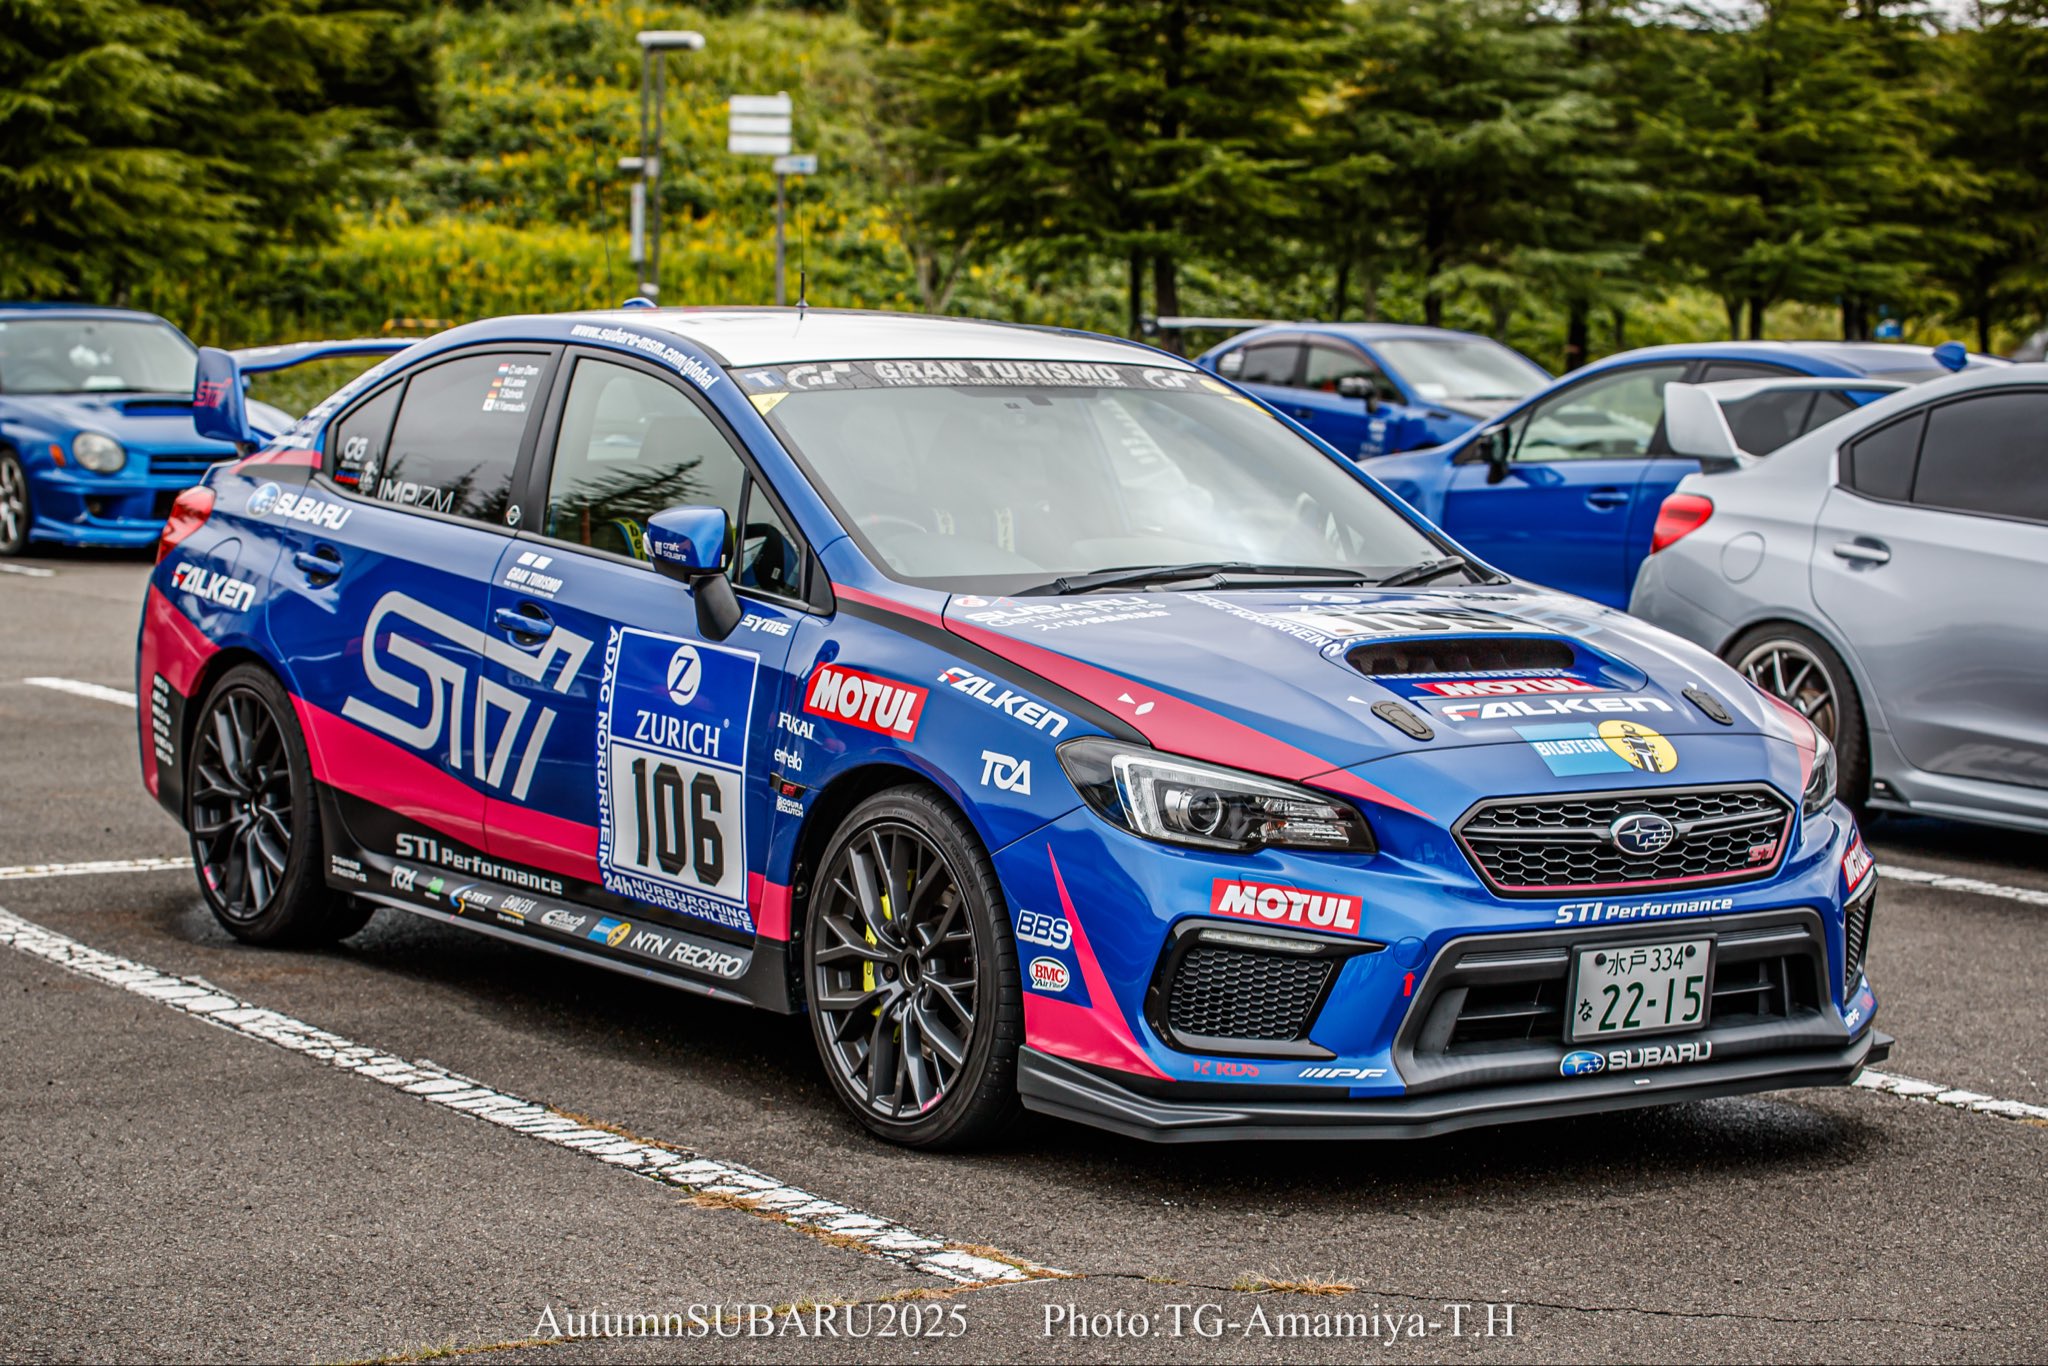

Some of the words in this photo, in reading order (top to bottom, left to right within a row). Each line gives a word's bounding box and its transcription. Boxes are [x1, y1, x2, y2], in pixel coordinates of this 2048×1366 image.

[874, 362, 968, 378] GRAN
[971, 361, 1120, 380] TURISMO
[344, 437, 368, 460] CG
[274, 491, 352, 531] SUBARU
[171, 562, 257, 612] FALKEN
[507, 567, 530, 583] GRAN
[526, 572, 563, 593] TURISMO
[966, 597, 1149, 621] SUBARU
[987, 609, 1096, 626] Genuine
[1097, 603, 1166, 612] Parts
[600, 626, 618, 702] ADAC
[809, 668, 915, 734] MOTUL
[938, 667, 1069, 738] FALKEN
[1434, 677, 1594, 697] MOTUL
[777, 712, 815, 739] FUKAI
[1442, 697, 1673, 721] FALKEN
[634, 710, 720, 758] ZURICH
[1531, 738, 1609, 756] BILSTEIN
[597, 711, 609, 869] NORDRHEIN
[980, 750, 1031, 796] TCA
[632, 758, 724, 887] 106
[396, 833, 437, 862] STI
[442, 847, 562, 895] Performance
[603, 871, 633, 897] 24h
[632, 878, 750, 921] NÜRBURGRING
[635, 890, 755, 933] NORDSCHLEIFE
[1217, 883, 1356, 929] MOTUL
[1555, 902, 1602, 924] STI
[1606, 898, 1732, 921] Performance
[630, 931, 671, 956] NTN
[1016, 909, 1072, 950] BBS
[668, 942, 743, 977] RECARO
[1035, 964, 1064, 983] BMC
[1607, 950, 1647, 976] 水戸
[1650, 946, 1684, 973] 334
[1578, 998, 1593, 1022] な
[1598, 975, 1704, 1031] 22-15
[1608, 1041, 1712, 1070] SUBARU
